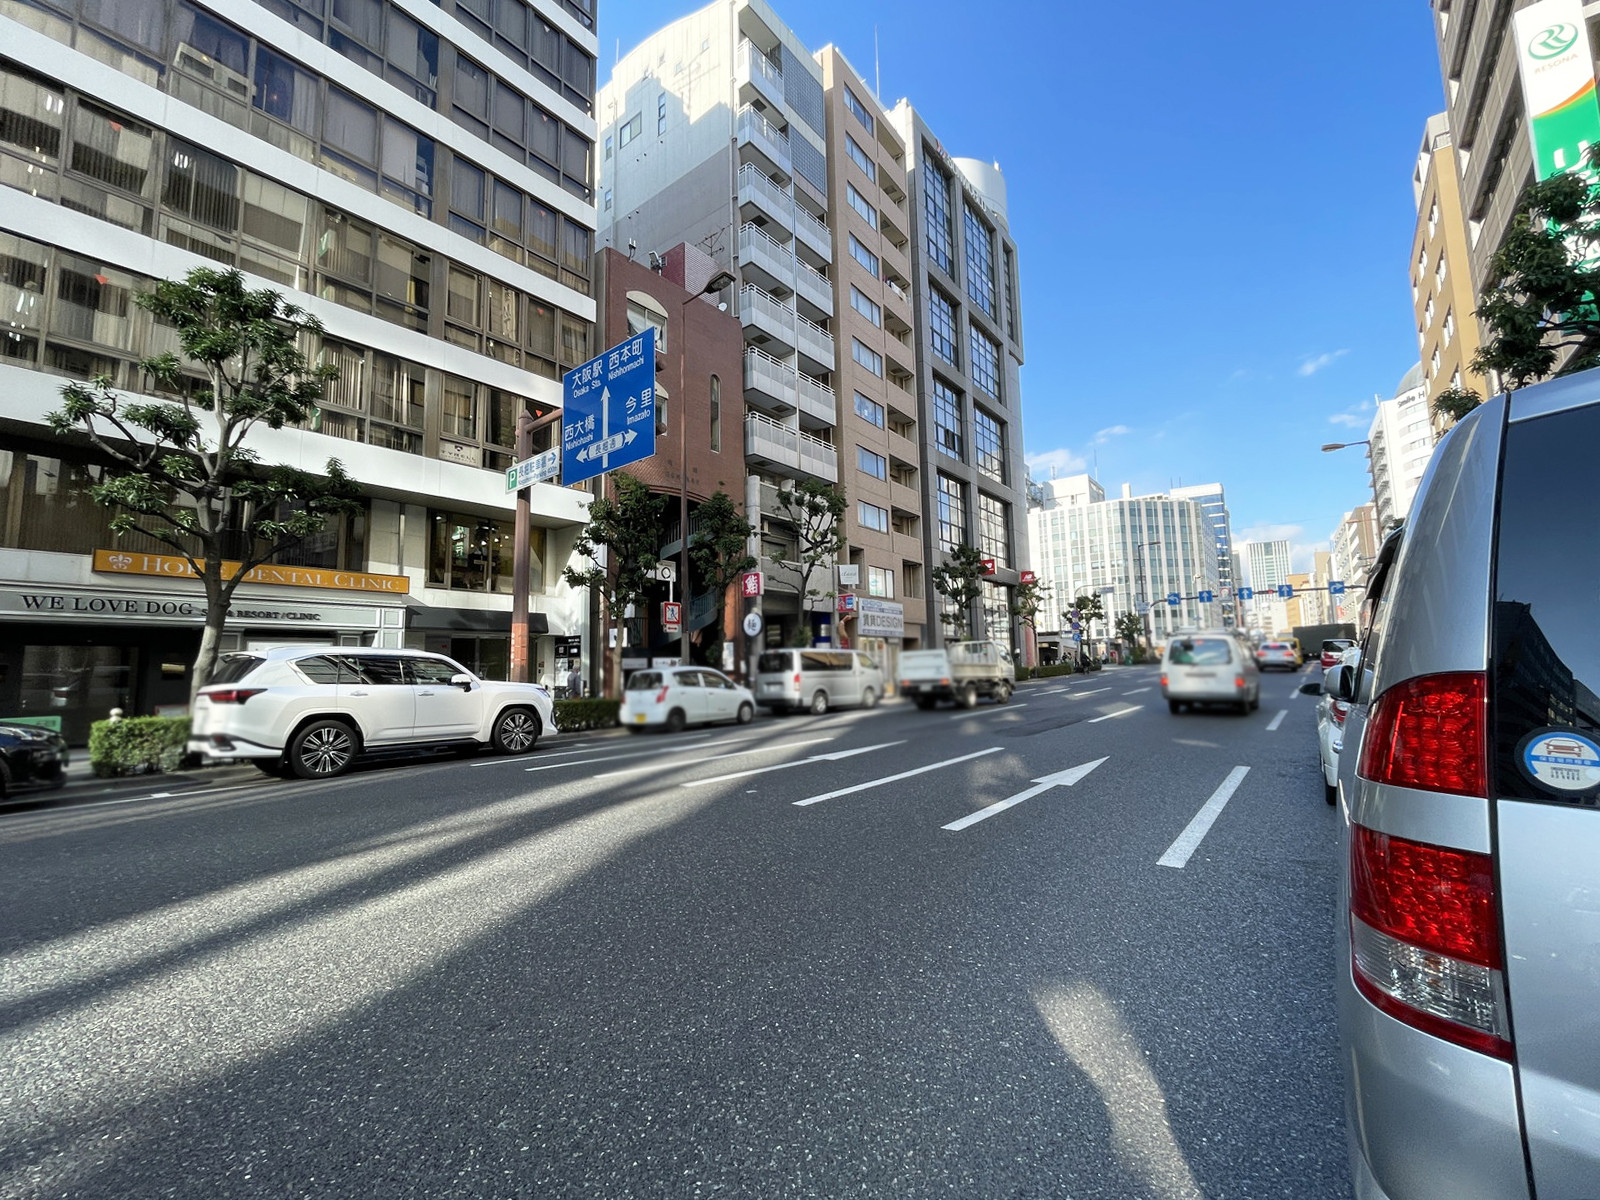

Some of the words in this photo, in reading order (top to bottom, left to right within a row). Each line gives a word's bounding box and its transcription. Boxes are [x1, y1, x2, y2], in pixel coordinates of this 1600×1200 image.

[1534, 53, 1578, 74] RESONA
[572, 359, 603, 389] 大阪駅
[608, 338, 643, 370] 西本町
[573, 385, 590, 398] Osaka
[608, 355, 644, 381] Nishihonmachi
[625, 387, 652, 414] 今里
[564, 413, 595, 442] 西大橋
[626, 409, 651, 426] Imazato
[509, 471, 516, 488] P
[334, 573, 400, 590] CLINIC
[20, 594, 64, 610] WE
[72, 597, 138, 613] LOVE
[146, 600, 193, 615] DOG
[236, 610, 280, 619] RESORT
